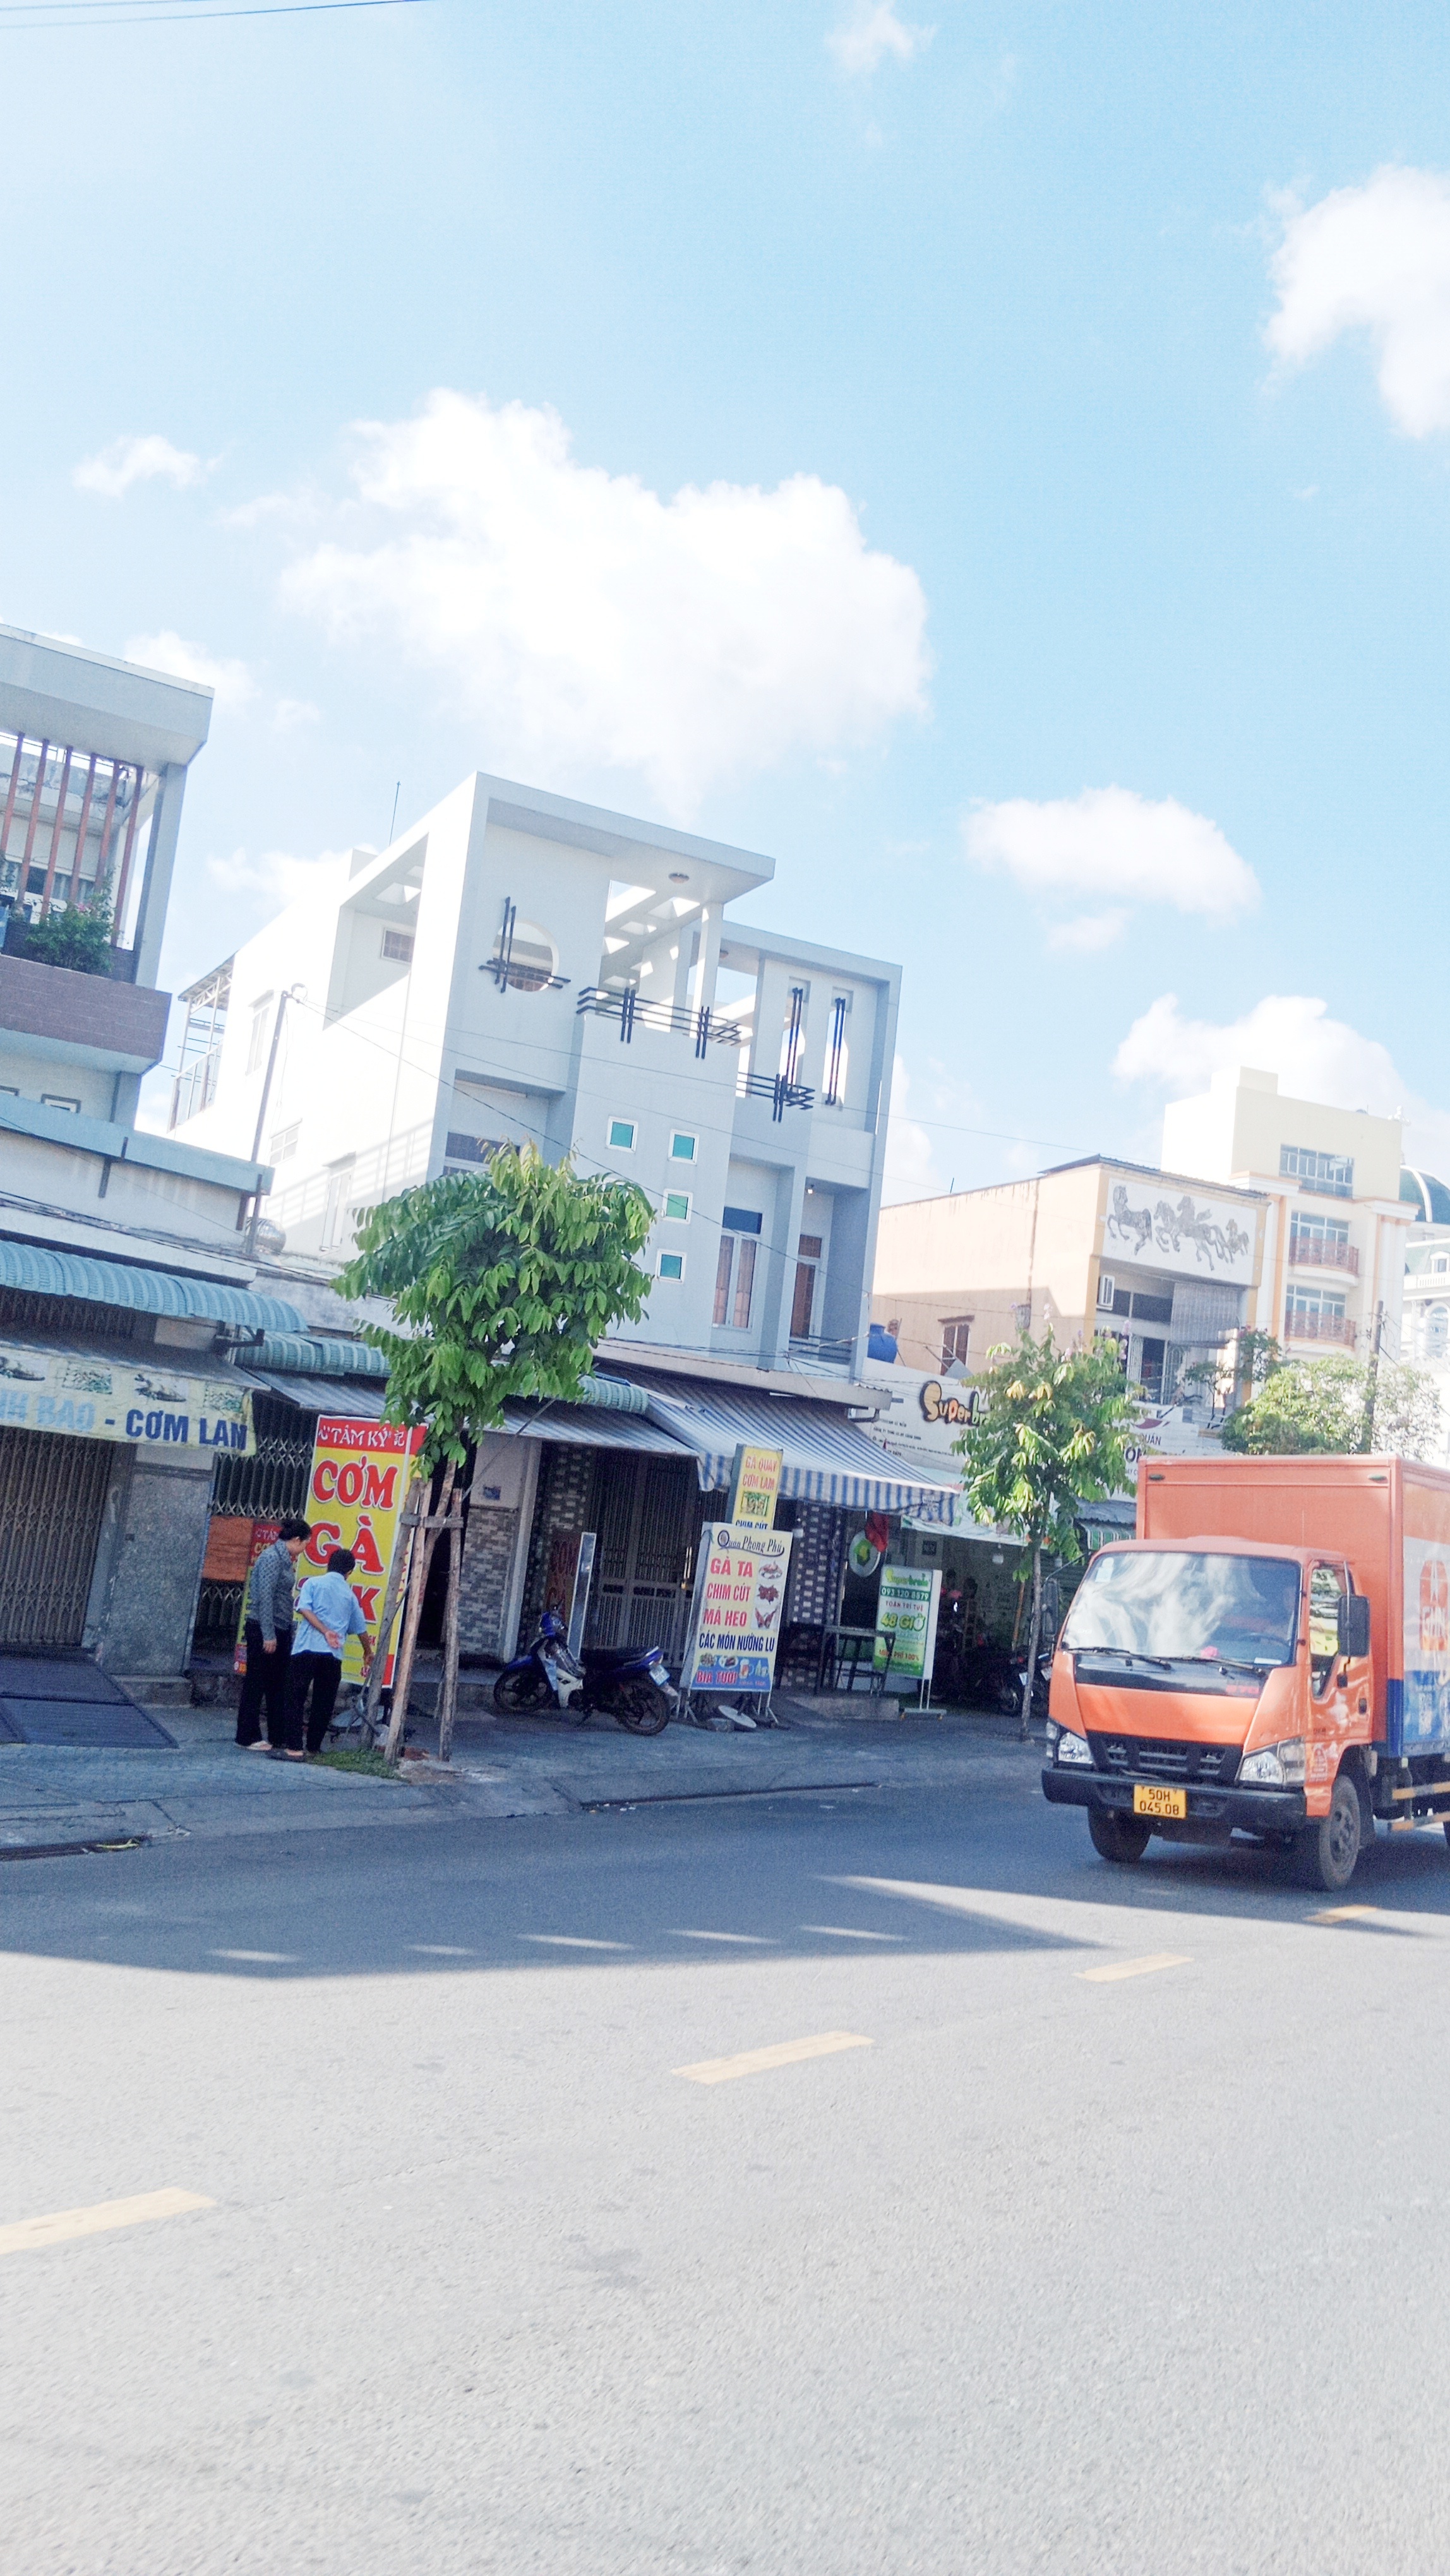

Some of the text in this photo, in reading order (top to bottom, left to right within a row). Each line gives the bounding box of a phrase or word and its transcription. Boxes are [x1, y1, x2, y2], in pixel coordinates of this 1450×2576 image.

[920, 1380, 990, 1427] Superbr
[37, 1396, 95, 1432] BAO
[126, 1409, 189, 1443] CƠM
[199, 1417, 248, 1451] LAN
[331, 1424, 365, 1446] TÂM
[746, 1456, 777, 1472] GÀ QUAY
[312, 1454, 399, 1510] CƠM
[743, 1473, 776, 1491] CƠM LAM
[304, 1515, 385, 1575] GÀ
[717, 1530, 782, 1553] Quán Phong Phú
[710, 1556, 753, 1577] GÀ TA
[707, 1582, 751, 1602] CHIM CÚT
[882, 1587, 894, 1596] 093
[703, 1606, 748, 1627] MÁ HEO
[698, 1630, 775, 1652] CÁC MÓN NƯỚNG LU
[696, 1671, 712, 1684] BIA
[1149, 1789, 1170, 1802] 50H
[1139, 1800, 1179, 1815] 045.08
